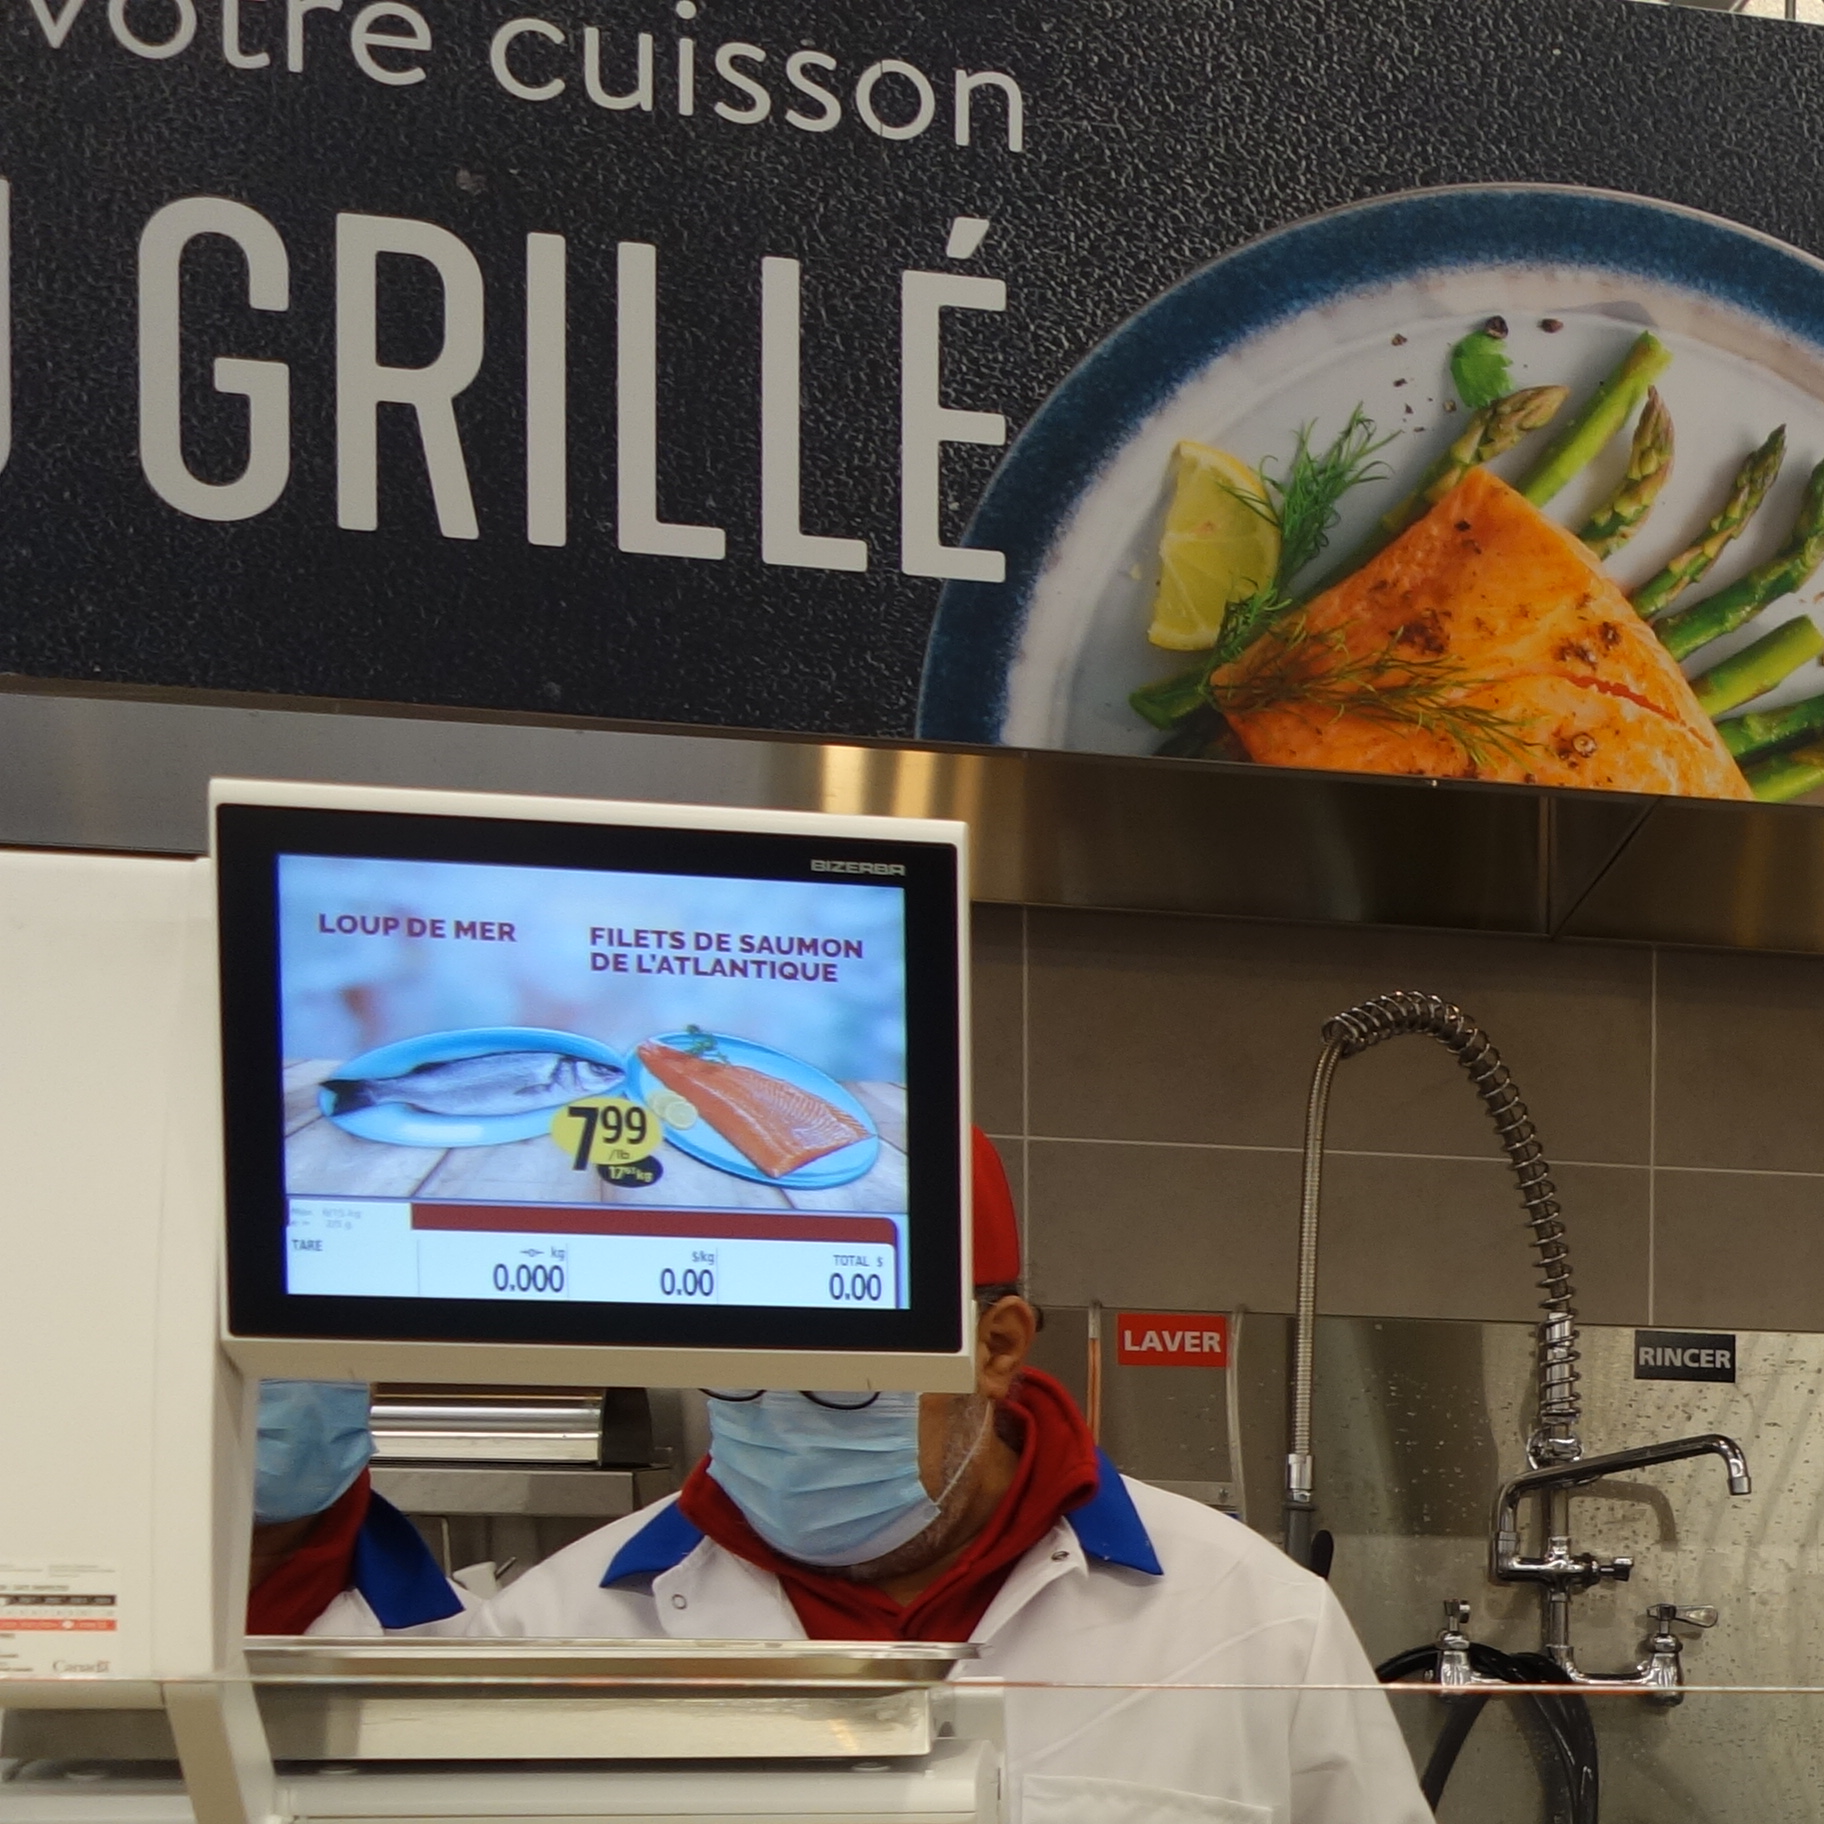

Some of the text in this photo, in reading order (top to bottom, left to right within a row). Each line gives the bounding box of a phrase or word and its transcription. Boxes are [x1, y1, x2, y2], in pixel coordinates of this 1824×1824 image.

[30, 0, 1023, 152] votre cuisson
[138, 196, 1006, 583] GRILLÉ
[810, 859, 906, 876] BIZERBA
[318, 913, 516, 942] LOUP DE MER
[589, 926, 864, 959] FILETS DE SAUMON
[590, 952, 838, 982] DE L'ATLANTIQUE
[292, 1239, 322, 1251] TARE
[551, 1247, 565, 1260] kg
[833, 1255, 870, 1267] TOTAL
[493, 1264, 565, 1293] 0.000
[660, 1267, 714, 1297] 0.00
[829, 1272, 882, 1301] 0.00
[1123, 1330, 1222, 1354] LAVER
[1638, 1346, 1732, 1370] RINCER
